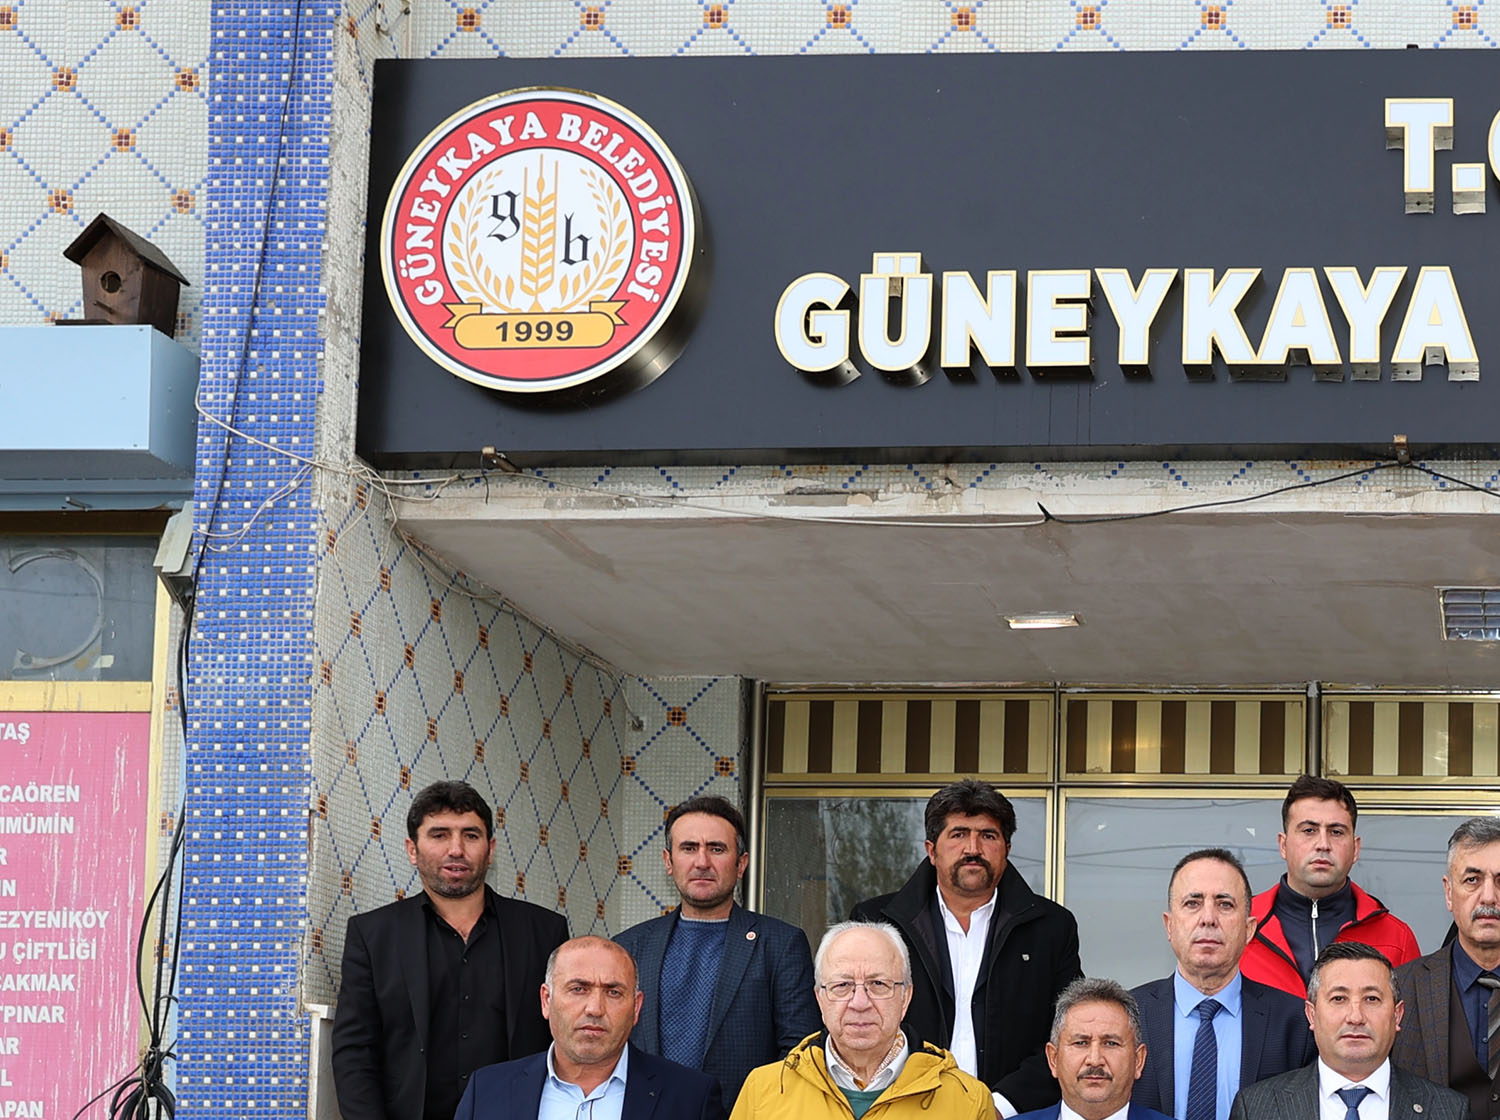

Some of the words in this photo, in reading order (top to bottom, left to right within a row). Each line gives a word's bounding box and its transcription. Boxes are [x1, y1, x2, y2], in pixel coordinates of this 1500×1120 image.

[398, 111, 548, 306] GÜNEYKAYA
[555, 111, 674, 304] BELEDİYESİ
[774, 251, 1480, 372] GÜNEYKAYA
[494, 320, 575, 343] 1999
[12, 937, 97, 965] ÇİFTLİĞİ
[0, 974, 76, 992] AKMAK
